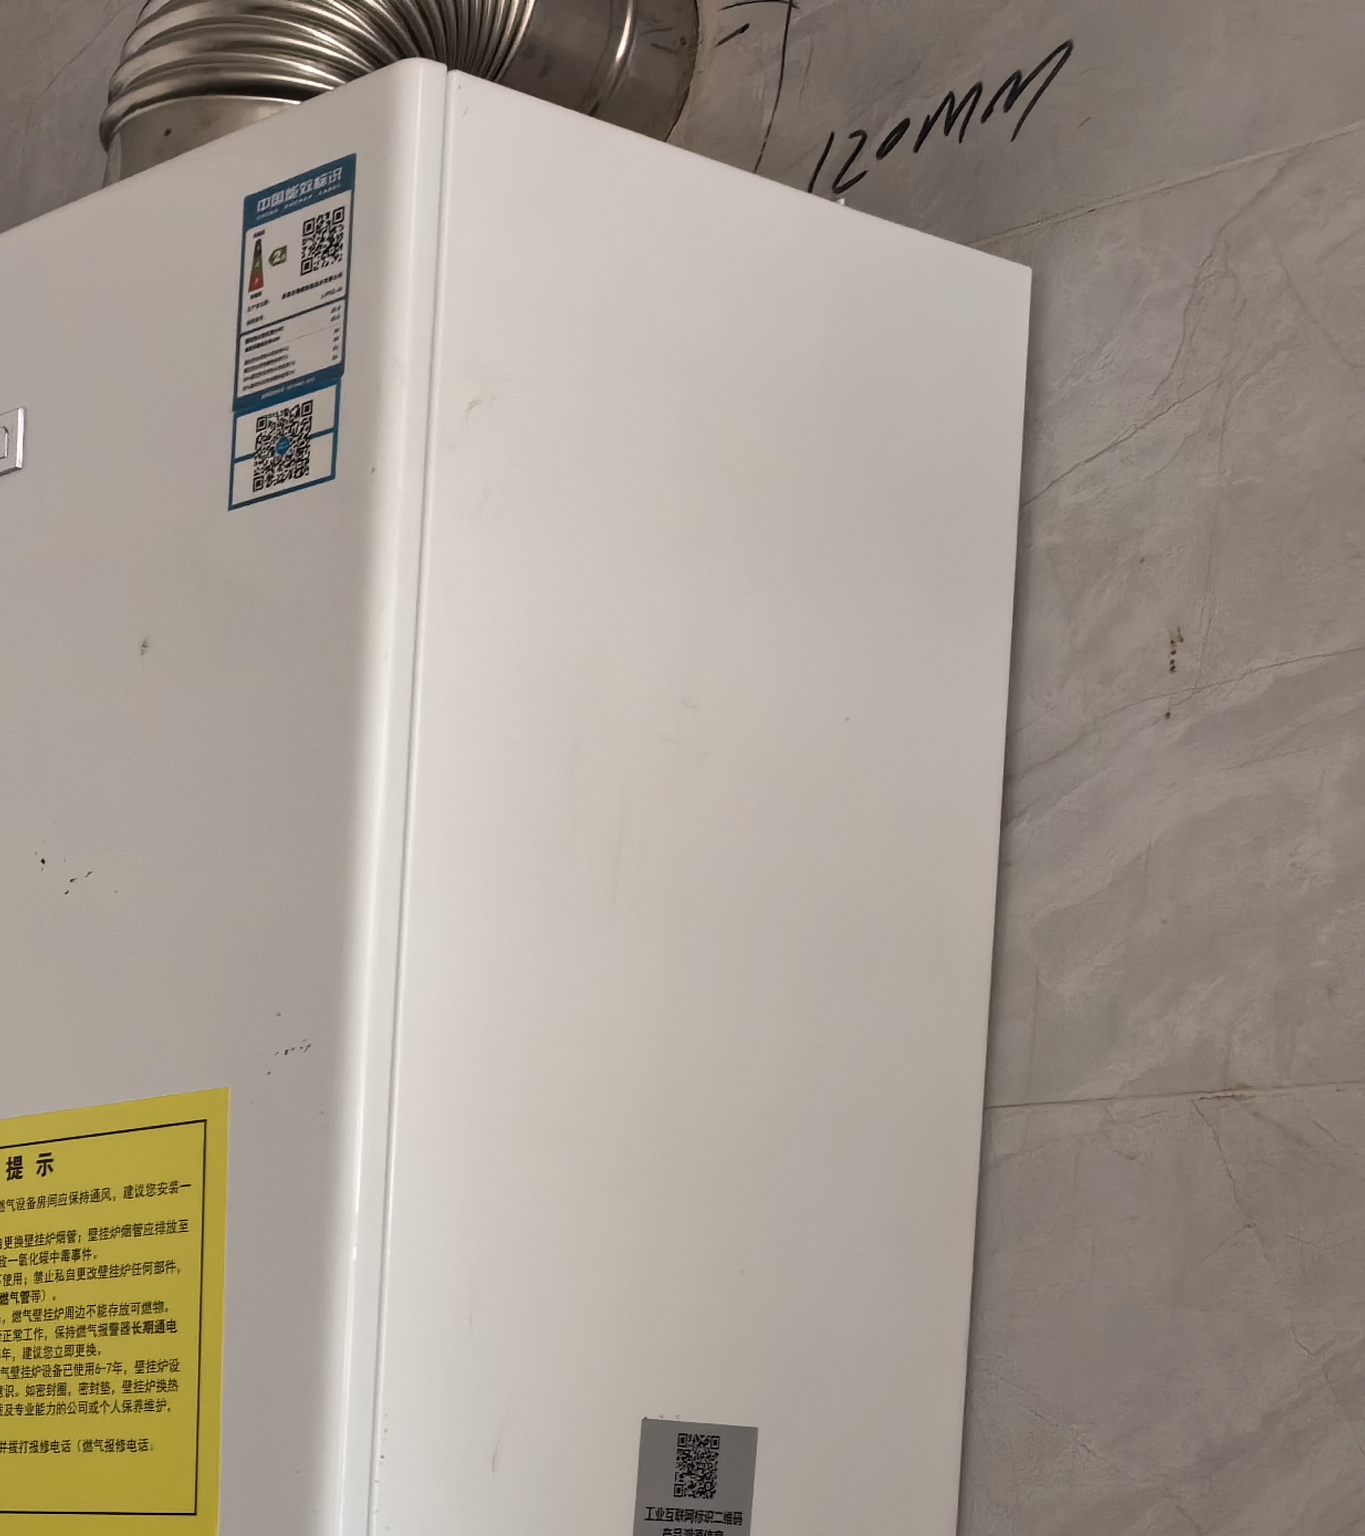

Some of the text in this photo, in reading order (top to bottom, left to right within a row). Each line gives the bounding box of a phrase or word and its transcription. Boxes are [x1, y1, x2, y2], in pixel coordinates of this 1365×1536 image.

[257, 167, 343, 212] 中国能效标识
[644, 1506, 743, 1525] 工业互联网标识二维码
